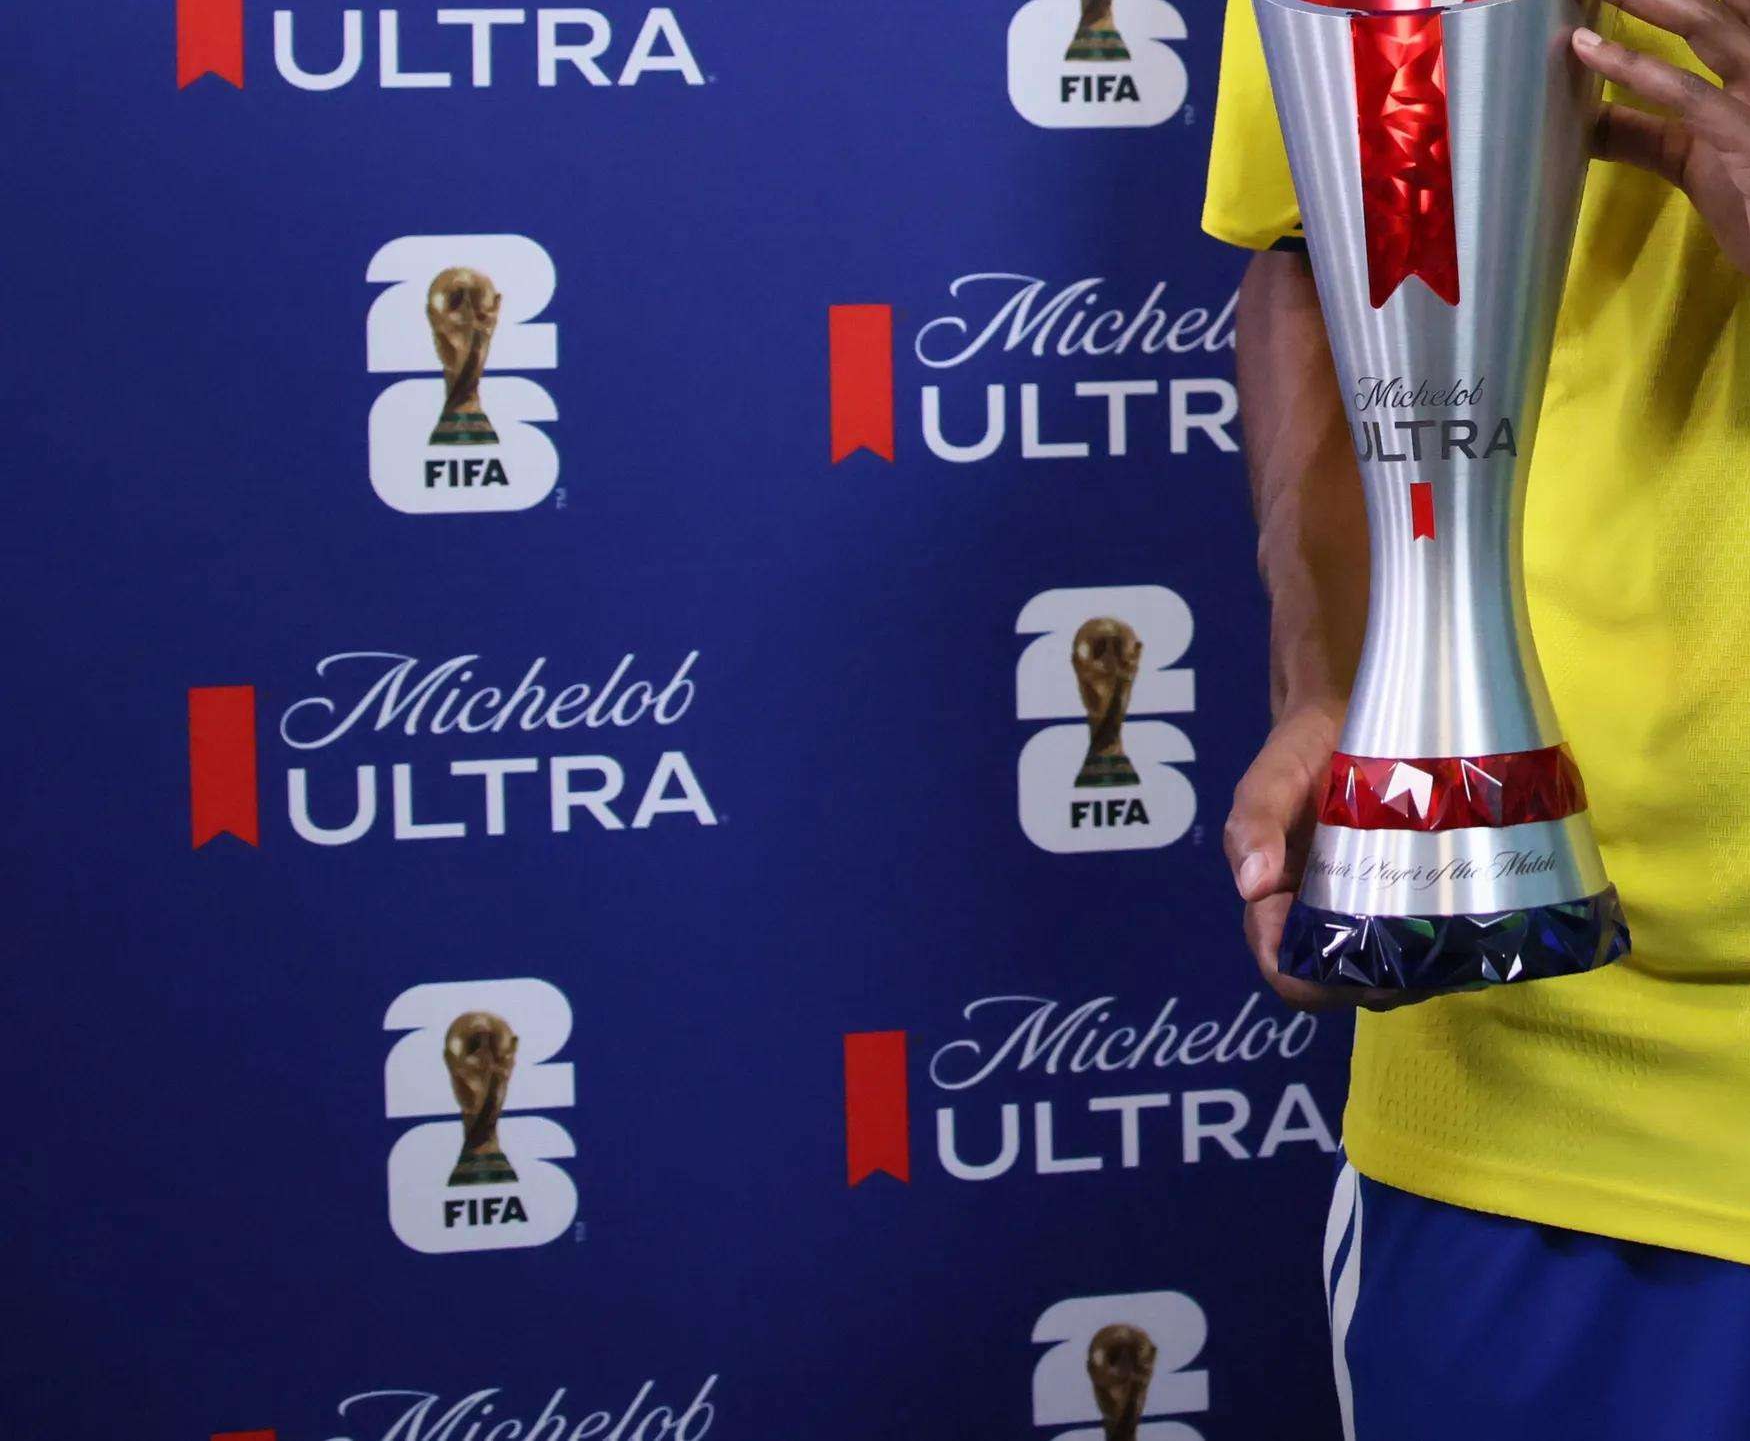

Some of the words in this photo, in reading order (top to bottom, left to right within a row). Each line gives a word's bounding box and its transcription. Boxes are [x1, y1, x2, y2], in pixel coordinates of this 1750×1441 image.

[274, 8, 705, 91] ULTRA
[1061, 75, 1140, 102] FIFA
[915, 273, 1240, 368] Michel
[921, 379, 1240, 463] ULTR
[1354, 376, 1486, 411] Michelob
[425, 459, 509, 487] FIFA
[280, 650, 699, 749] Michelob
[288, 751, 718, 845] ULTRA
[1071, 799, 1149, 828] FIFA
[1412, 858, 1464, 891] of
[1449, 860, 1479, 880] the
[937, 1084, 1337, 1180] ULTRA
[445, 1196, 528, 1228] FIFA
